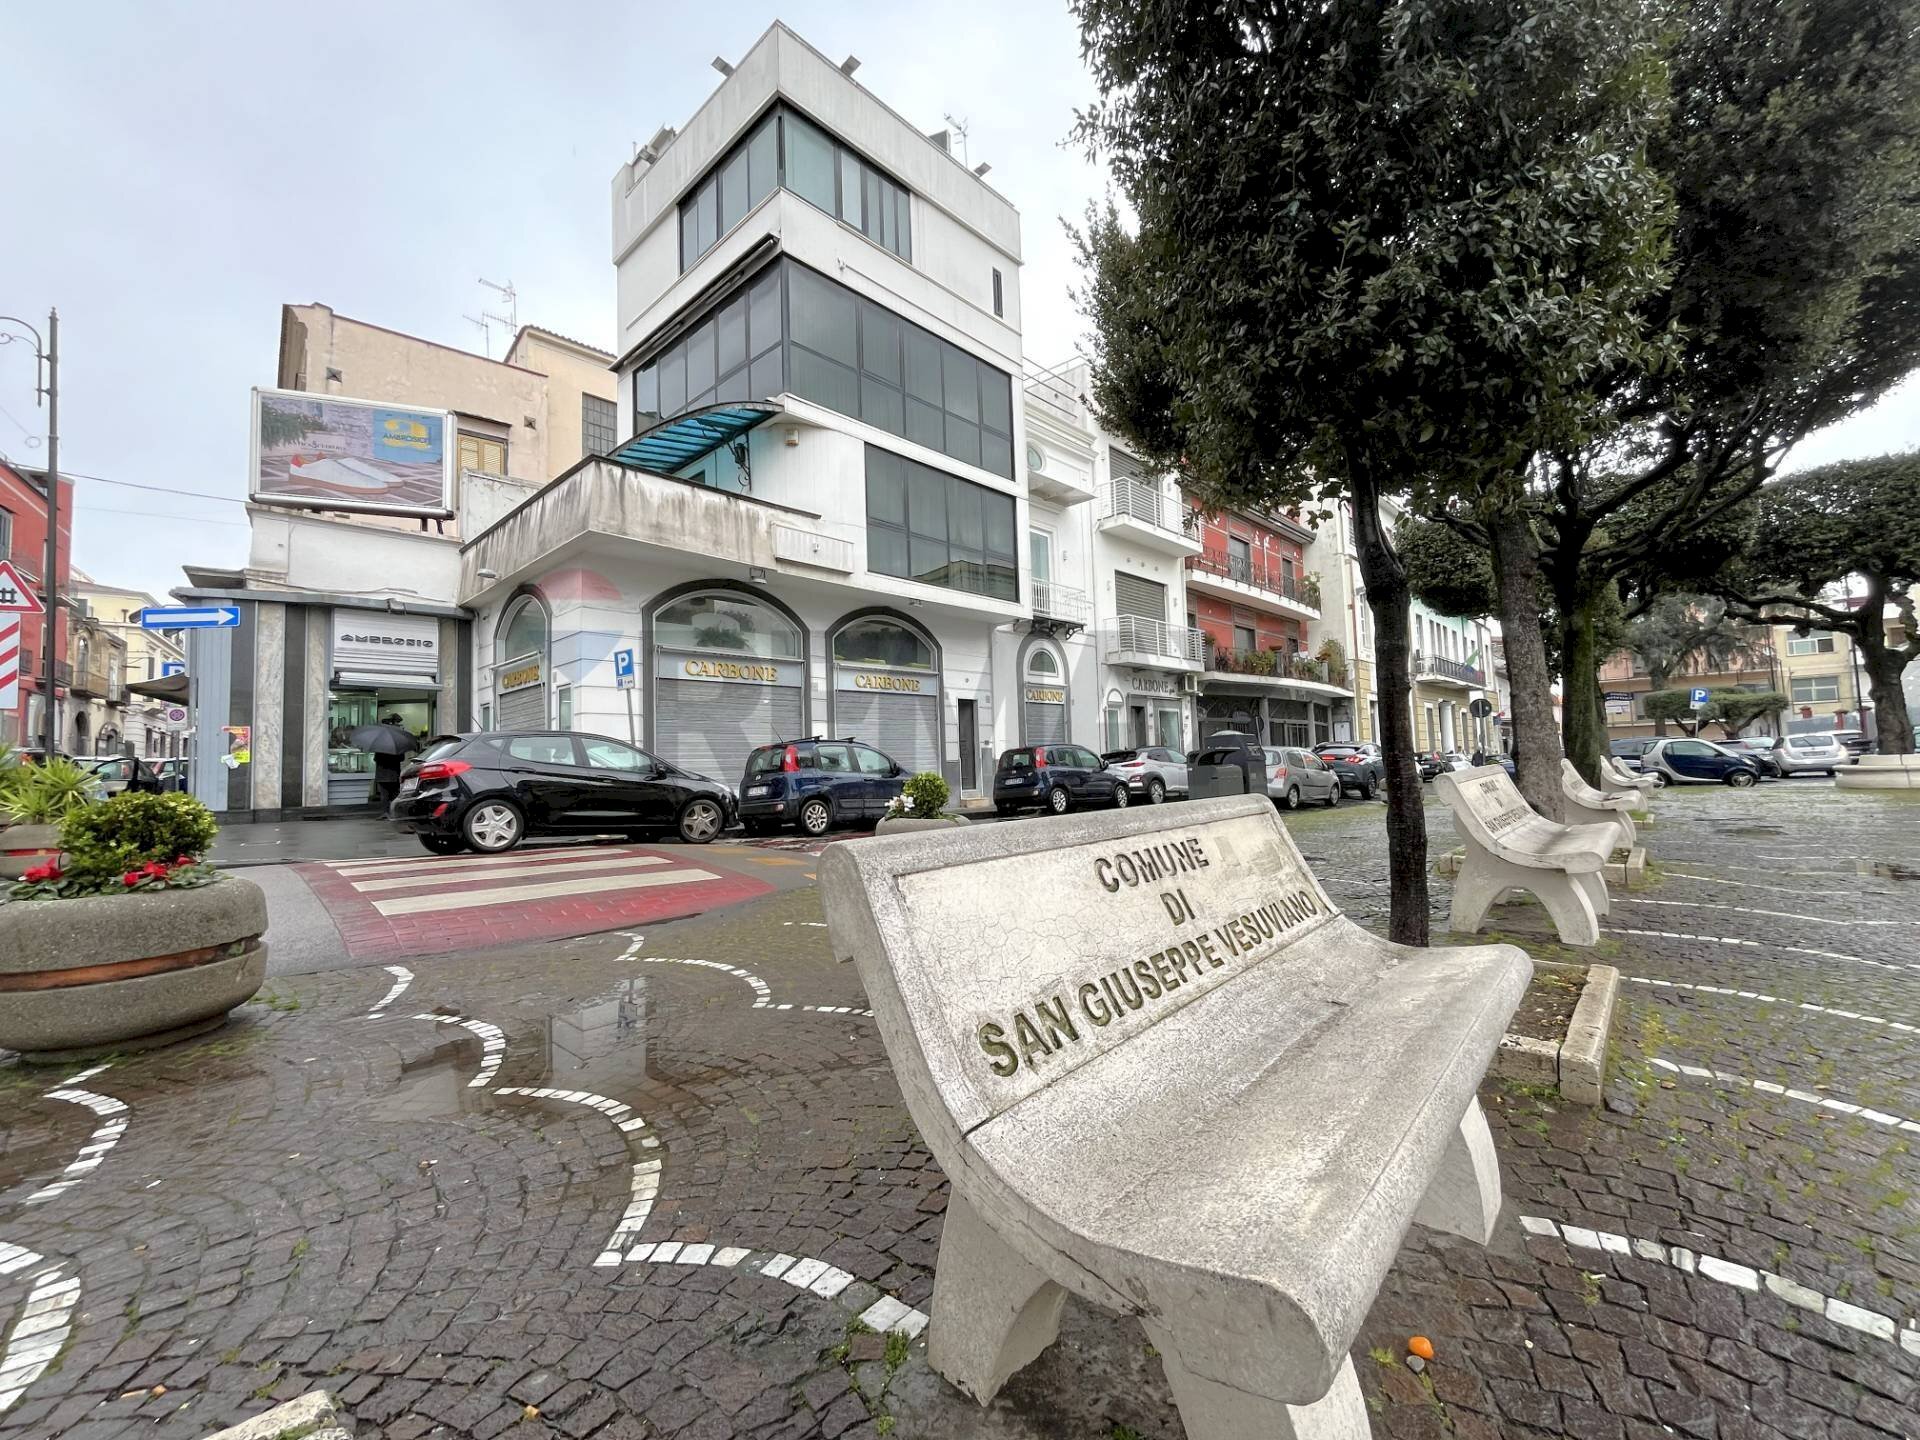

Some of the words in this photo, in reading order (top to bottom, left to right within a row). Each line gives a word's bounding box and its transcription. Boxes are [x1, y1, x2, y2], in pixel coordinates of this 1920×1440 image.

[340, 634, 434, 648] AMBROSIO
[617, 652, 630, 675] P
[685, 659, 777, 682] CARBONE
[855, 673, 921, 692] CARBONE
[1694, 689, 1705, 701] P
[1094, 838, 1210, 893] COMUNE
[1159, 888, 1196, 926] DI
[978, 996, 1080, 1078] SAN
[1078, 934, 1225, 1027] GIUSEPPE
[1216, 890, 1318, 957] VESUVIANO
